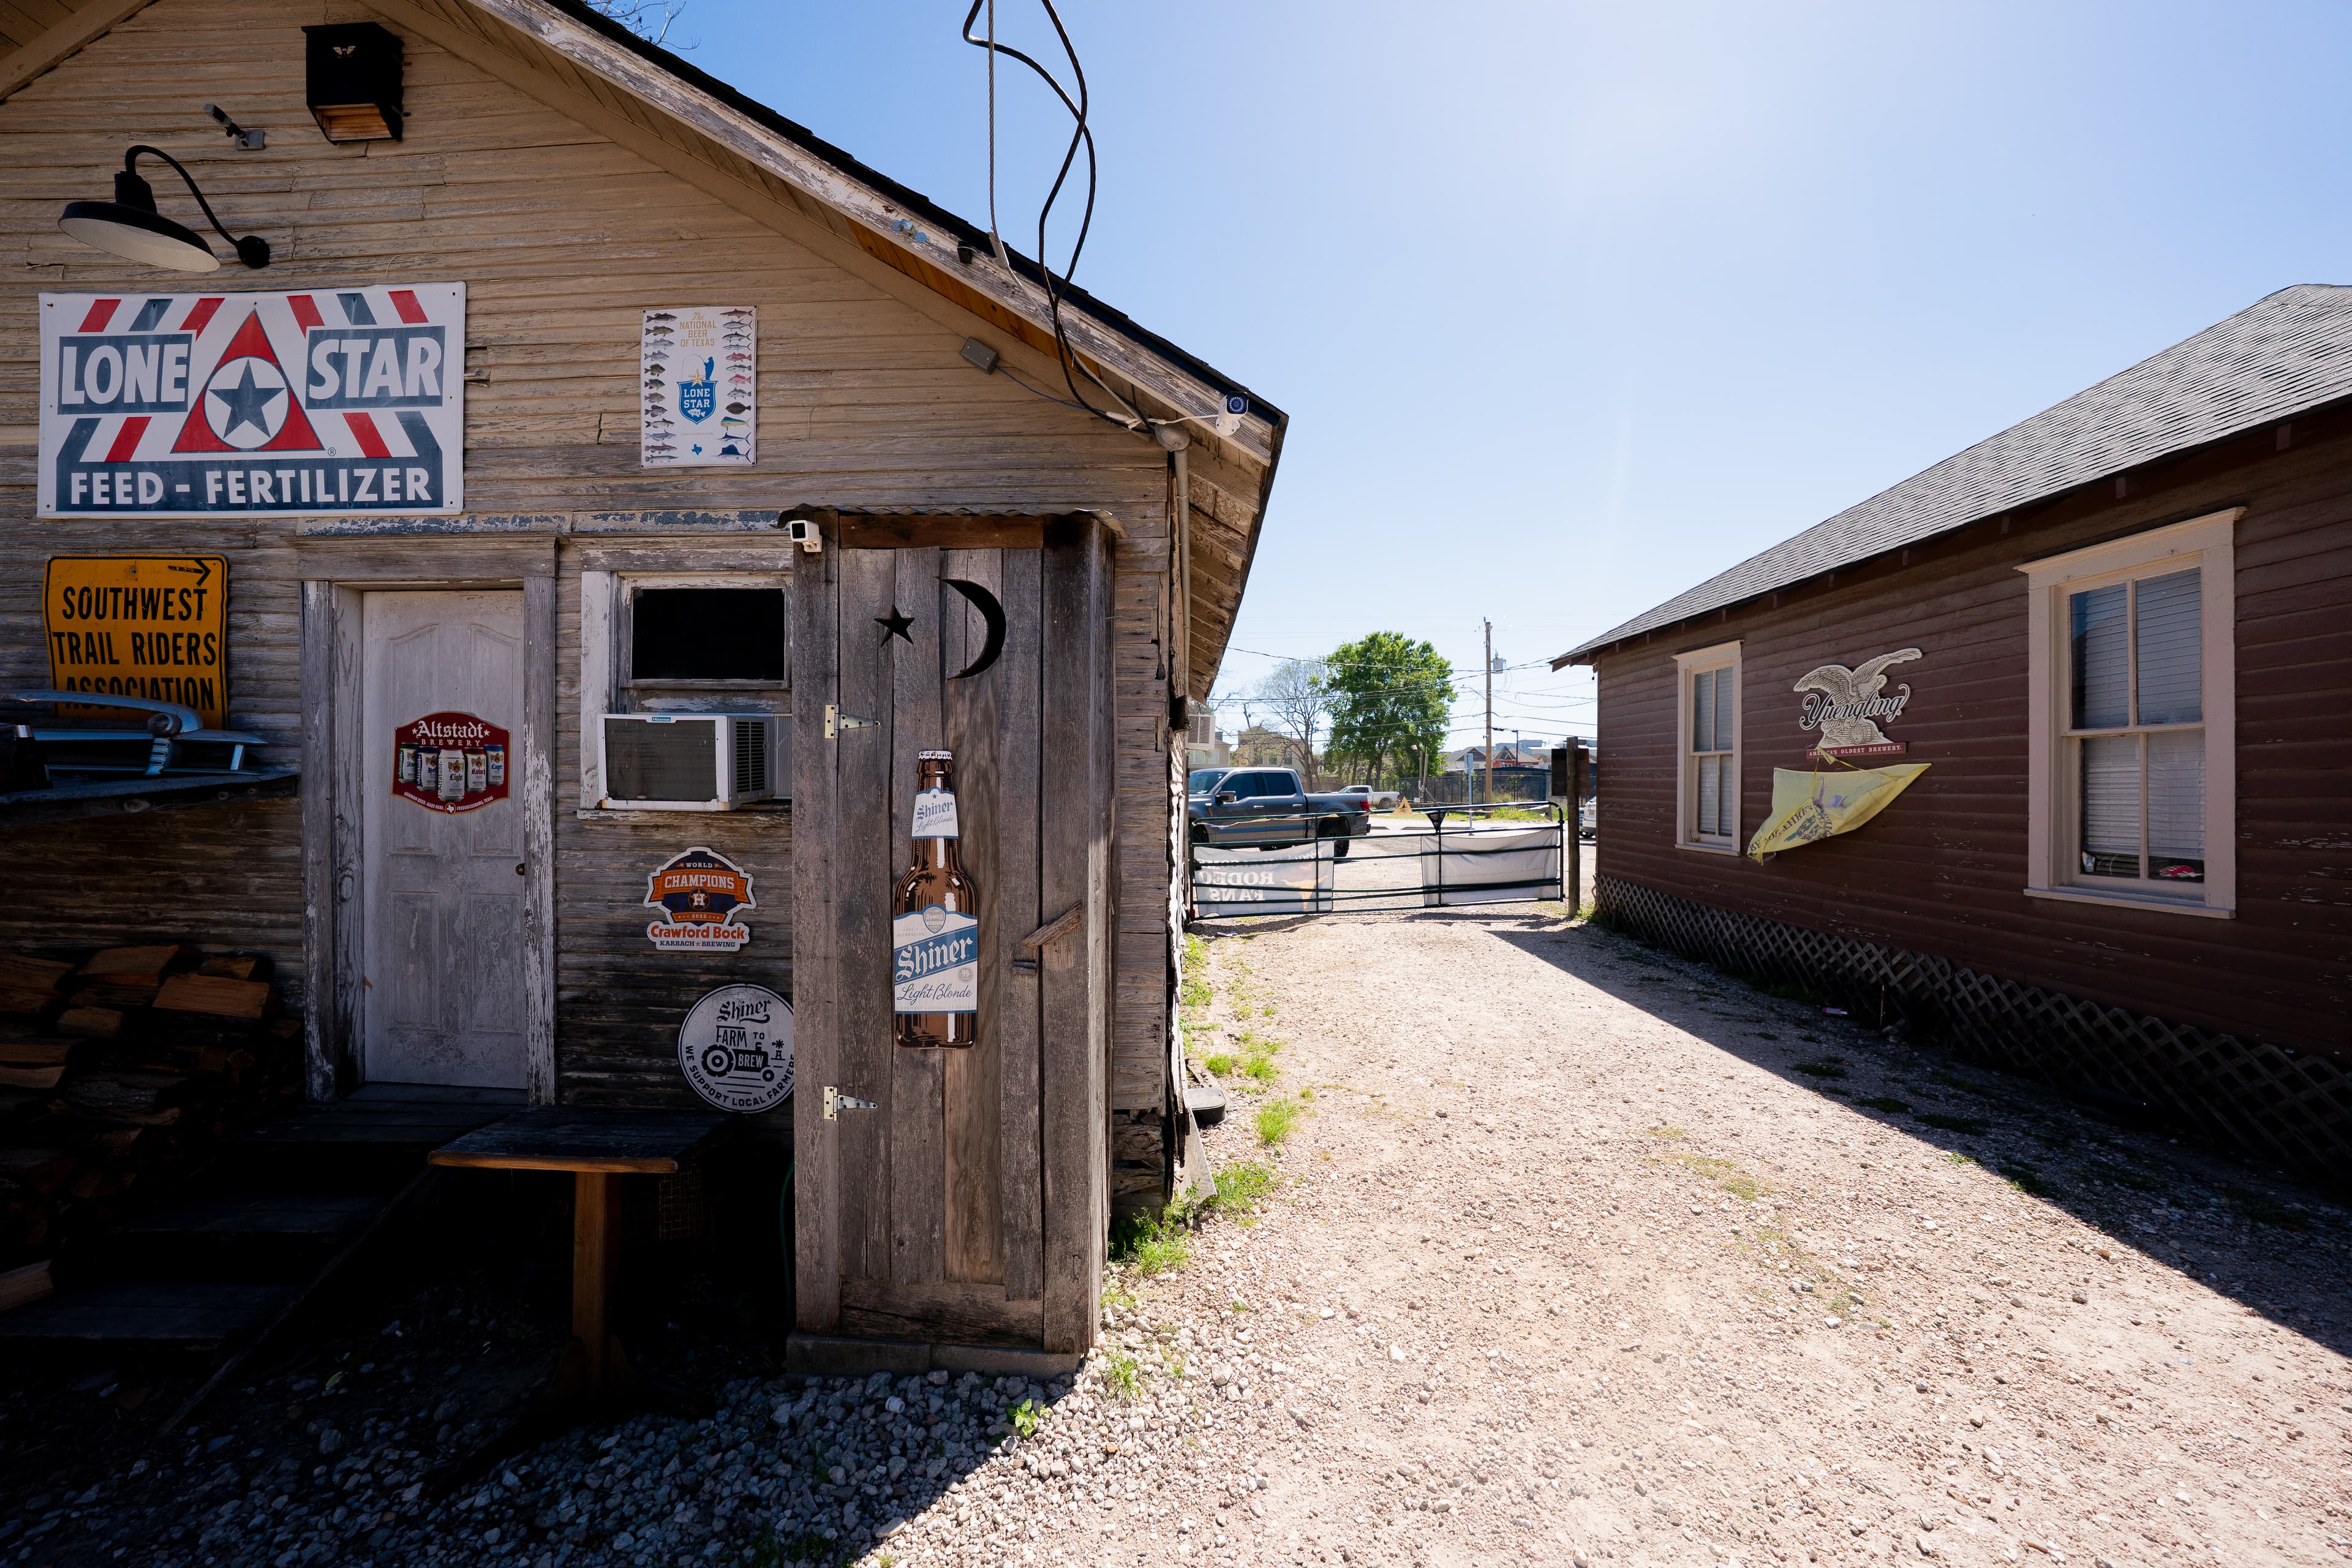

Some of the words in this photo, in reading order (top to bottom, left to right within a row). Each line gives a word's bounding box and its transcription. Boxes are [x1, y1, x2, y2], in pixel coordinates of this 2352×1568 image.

[679, 321, 717, 330] NATIONAL
[688, 330, 707, 338] BEER
[680, 339, 689, 347] OF
[692, 338, 715, 347] TEXAS
[62, 343, 189, 405] LONE
[309, 337, 442, 399] STAR
[684, 388, 710, 398] LONE
[684, 399, 710, 409] STAR
[71, 472, 164, 505] FEED
[206, 467, 432, 504] FERTILIZER
[62, 586, 208, 621] SOUTHWEST
[53, 631, 120, 665] TRAIL
[131, 632, 216, 666] RIDERS
[66, 676, 215, 711] ASSOCIATION
[1800, 684, 1910, 730] Yuengling
[416, 720, 484, 739] Altstadt
[404, 791, 417, 801] GERMAN
[916, 801, 954, 821] Shiner
[915, 820, 933, 833] Light
[933, 815, 954, 827] Blonde
[665, 874, 735, 889] CHAMPIONS
[650, 925, 710, 938] Crawford
[713, 926, 745, 940] Bock
[895, 937, 973, 981] Shiner
[897, 983, 934, 1006] Light
[932, 983, 972, 1000] Blonde
[716, 999, 772, 1023] Shiner
[716, 1025, 747, 1047] FARM
[685, 1045, 695, 1062] WE
[738, 1054, 764, 1068] BREW
[689, 1065, 729, 1103] SUPPORT
[732, 1095, 766, 1107] LOCAL
